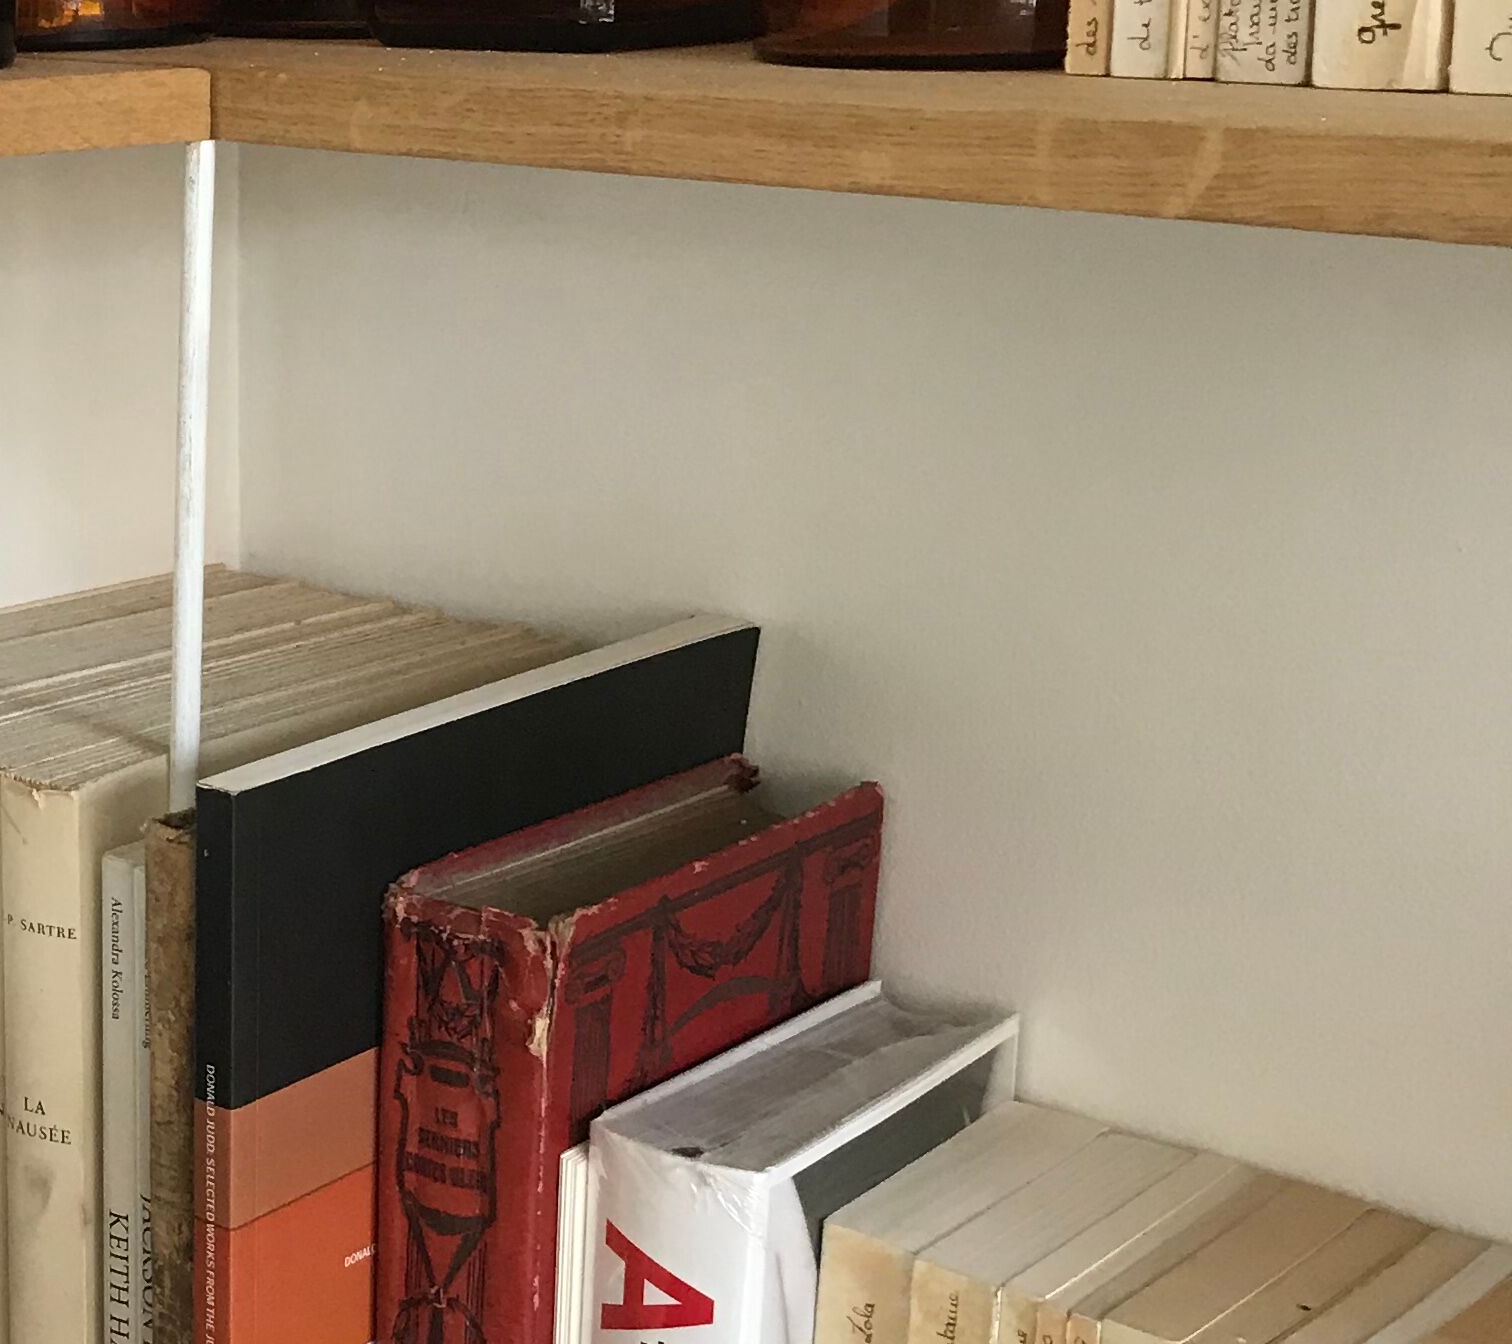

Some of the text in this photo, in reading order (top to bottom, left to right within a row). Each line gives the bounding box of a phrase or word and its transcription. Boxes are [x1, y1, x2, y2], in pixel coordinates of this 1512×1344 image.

[20, 919, 78, 941] SARTRE
[111, 896, 123, 1021] Alexandra Kolossa
[204, 1064, 215, 1116] DONALD
[7, 1097, 73, 1146] LA NAUSÉE
[204, 1157, 215, 1221] SELECTED
[107, 1209, 131, 1307] KEITH
[204, 1223, 215, 1269] WORKS
[204, 1270, 215, 1307] FROM
[204, 1308, 215, 1331] THE
